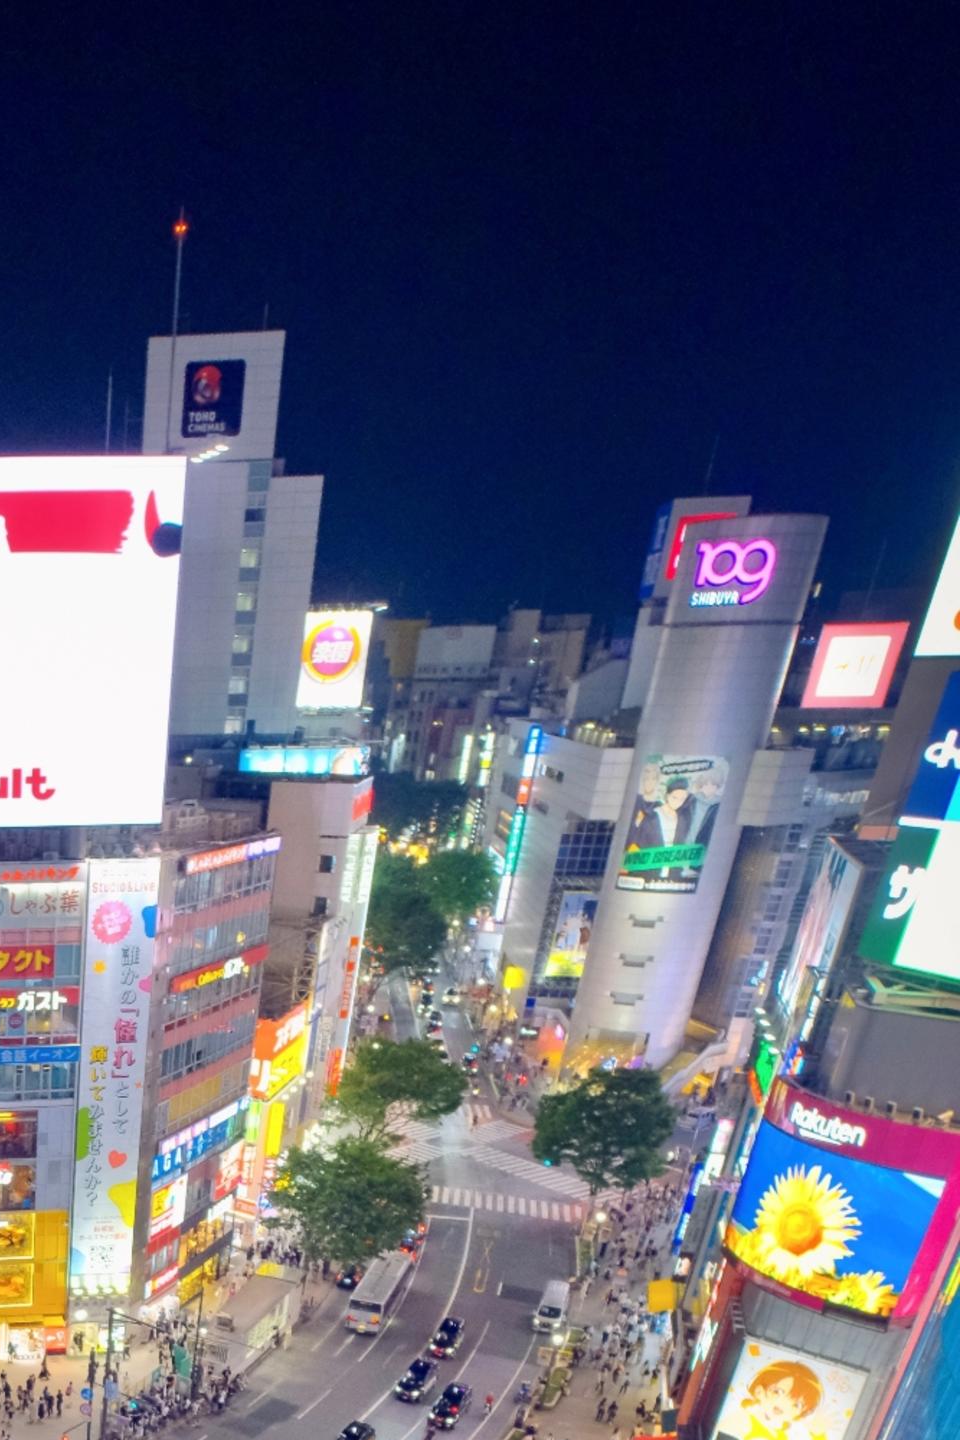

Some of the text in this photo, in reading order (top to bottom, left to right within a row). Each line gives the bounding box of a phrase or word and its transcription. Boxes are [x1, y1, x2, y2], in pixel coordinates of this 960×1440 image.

[694, 538, 777, 605] 109
[690, 591, 740, 608] SHIBUYA
[10, 889, 80, 916] しゃぶ葉
[16, 990, 68, 1012] ガスト
[789, 1101, 866, 1147] Rakuten
